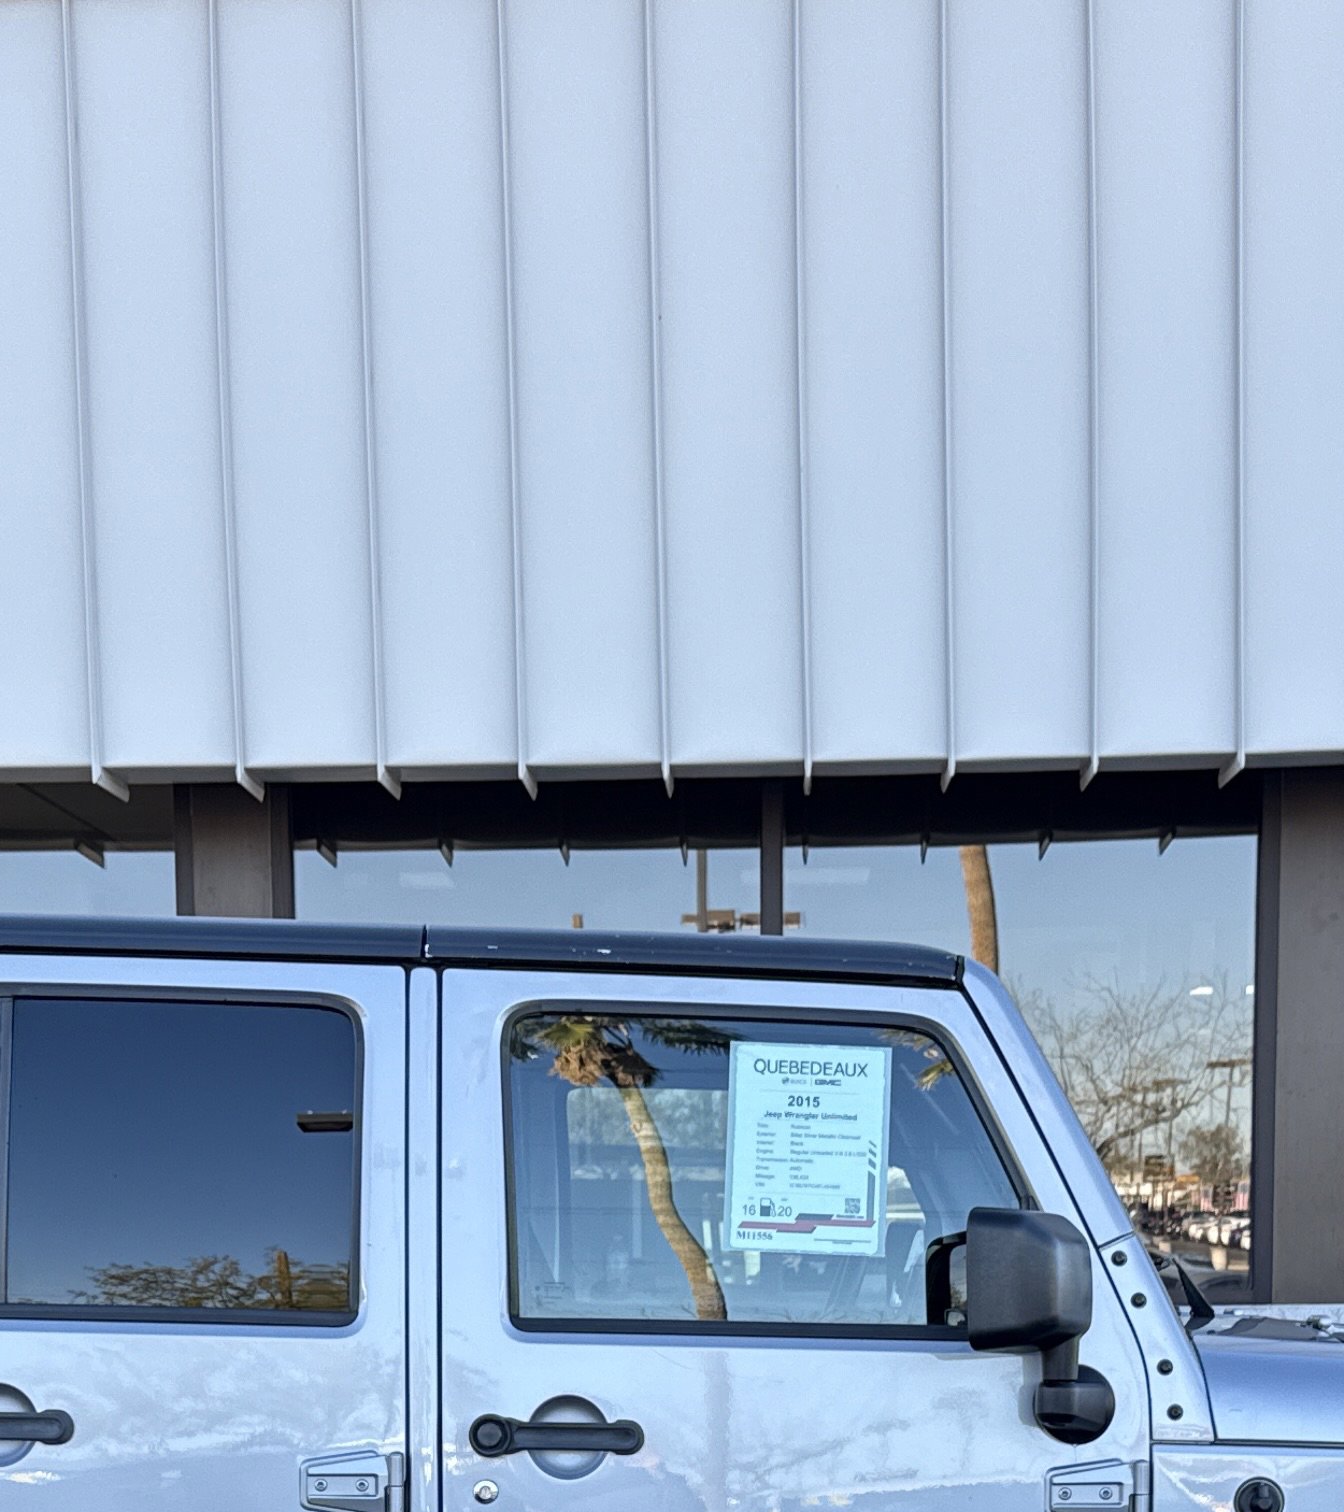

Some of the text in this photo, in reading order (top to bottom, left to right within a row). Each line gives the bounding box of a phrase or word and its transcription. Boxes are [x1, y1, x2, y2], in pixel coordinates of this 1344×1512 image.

[753, 1058, 869, 1078] QUEBEDEAUX
[787, 1095, 821, 1108] 2015
[763, 1110, 858, 1121] Jeep Wrangler Unlimited
[742, 1204, 756, 1216] 16
[777, 1206, 792, 1217] 20
